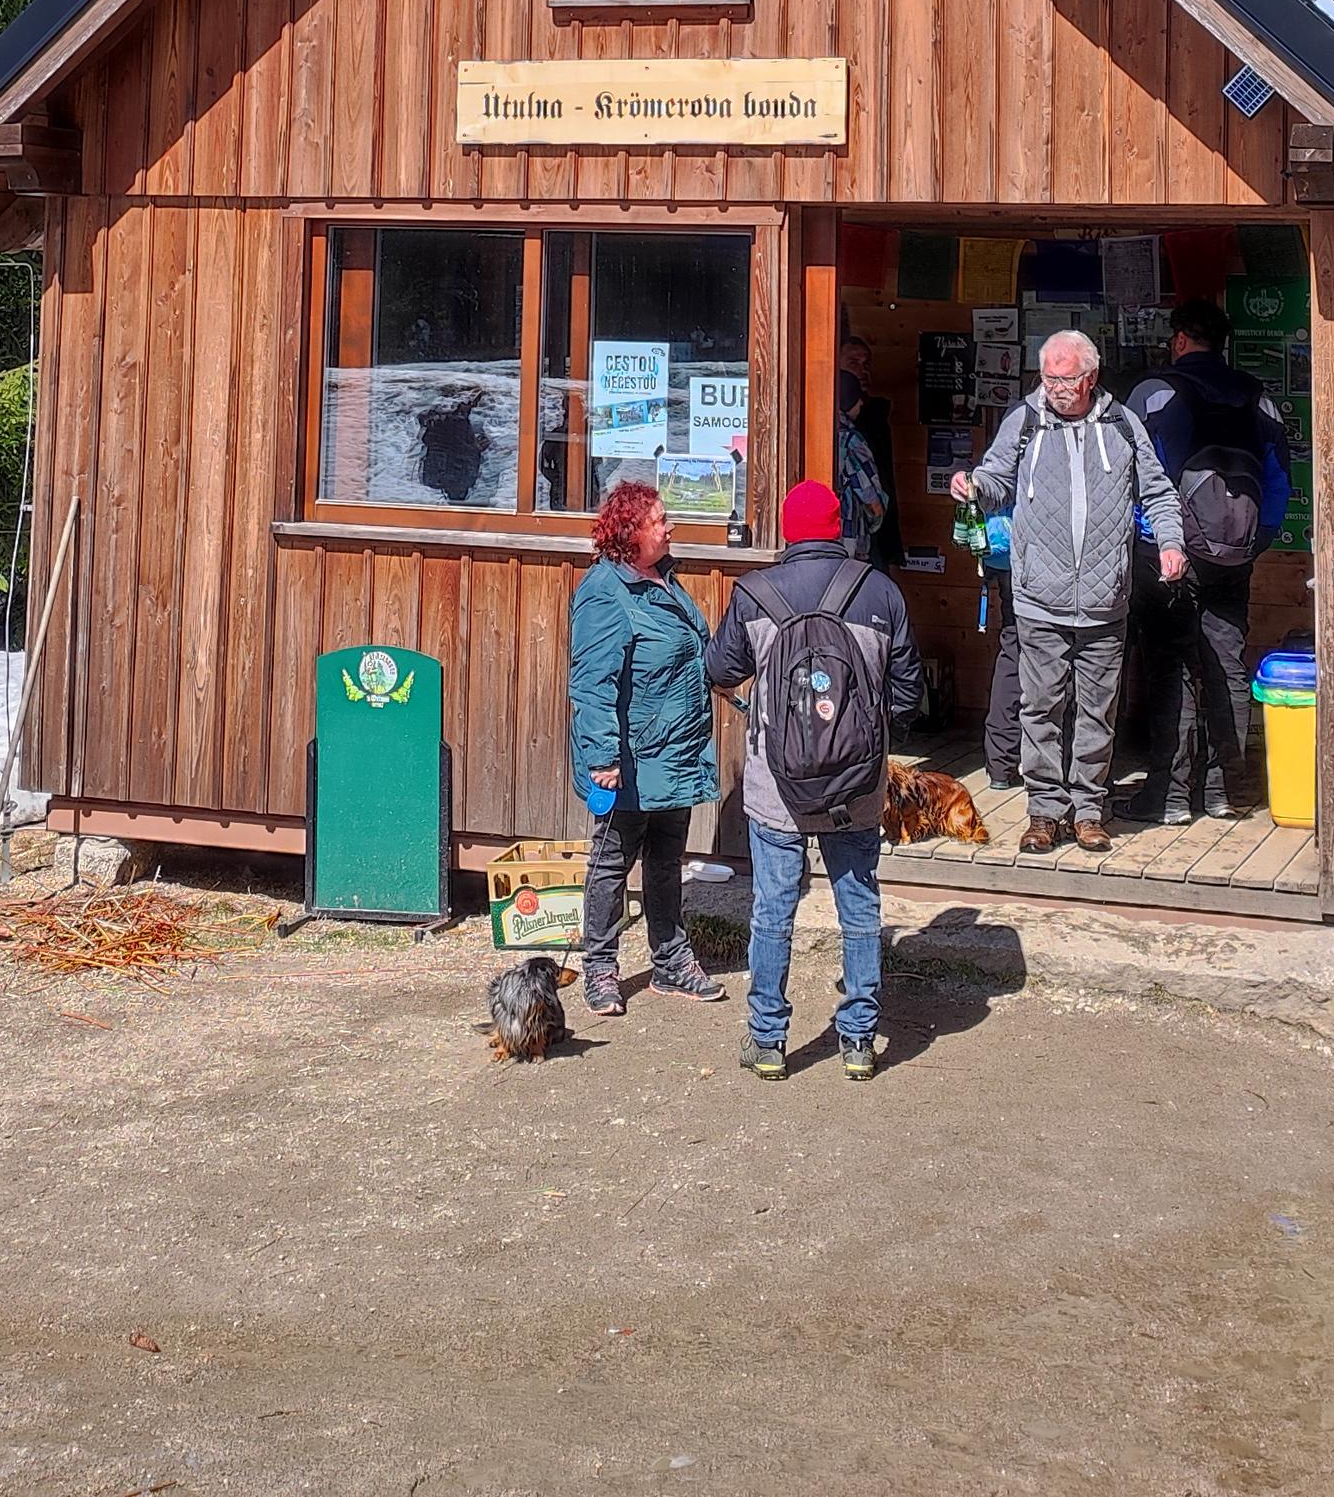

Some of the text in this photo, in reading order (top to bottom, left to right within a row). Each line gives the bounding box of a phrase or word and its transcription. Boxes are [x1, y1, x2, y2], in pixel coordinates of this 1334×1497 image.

[594, 90, 732, 120] Krömerova
[606, 355, 656, 372] CESTOU
[513, 908, 581, 941] Pilsner Urquell
